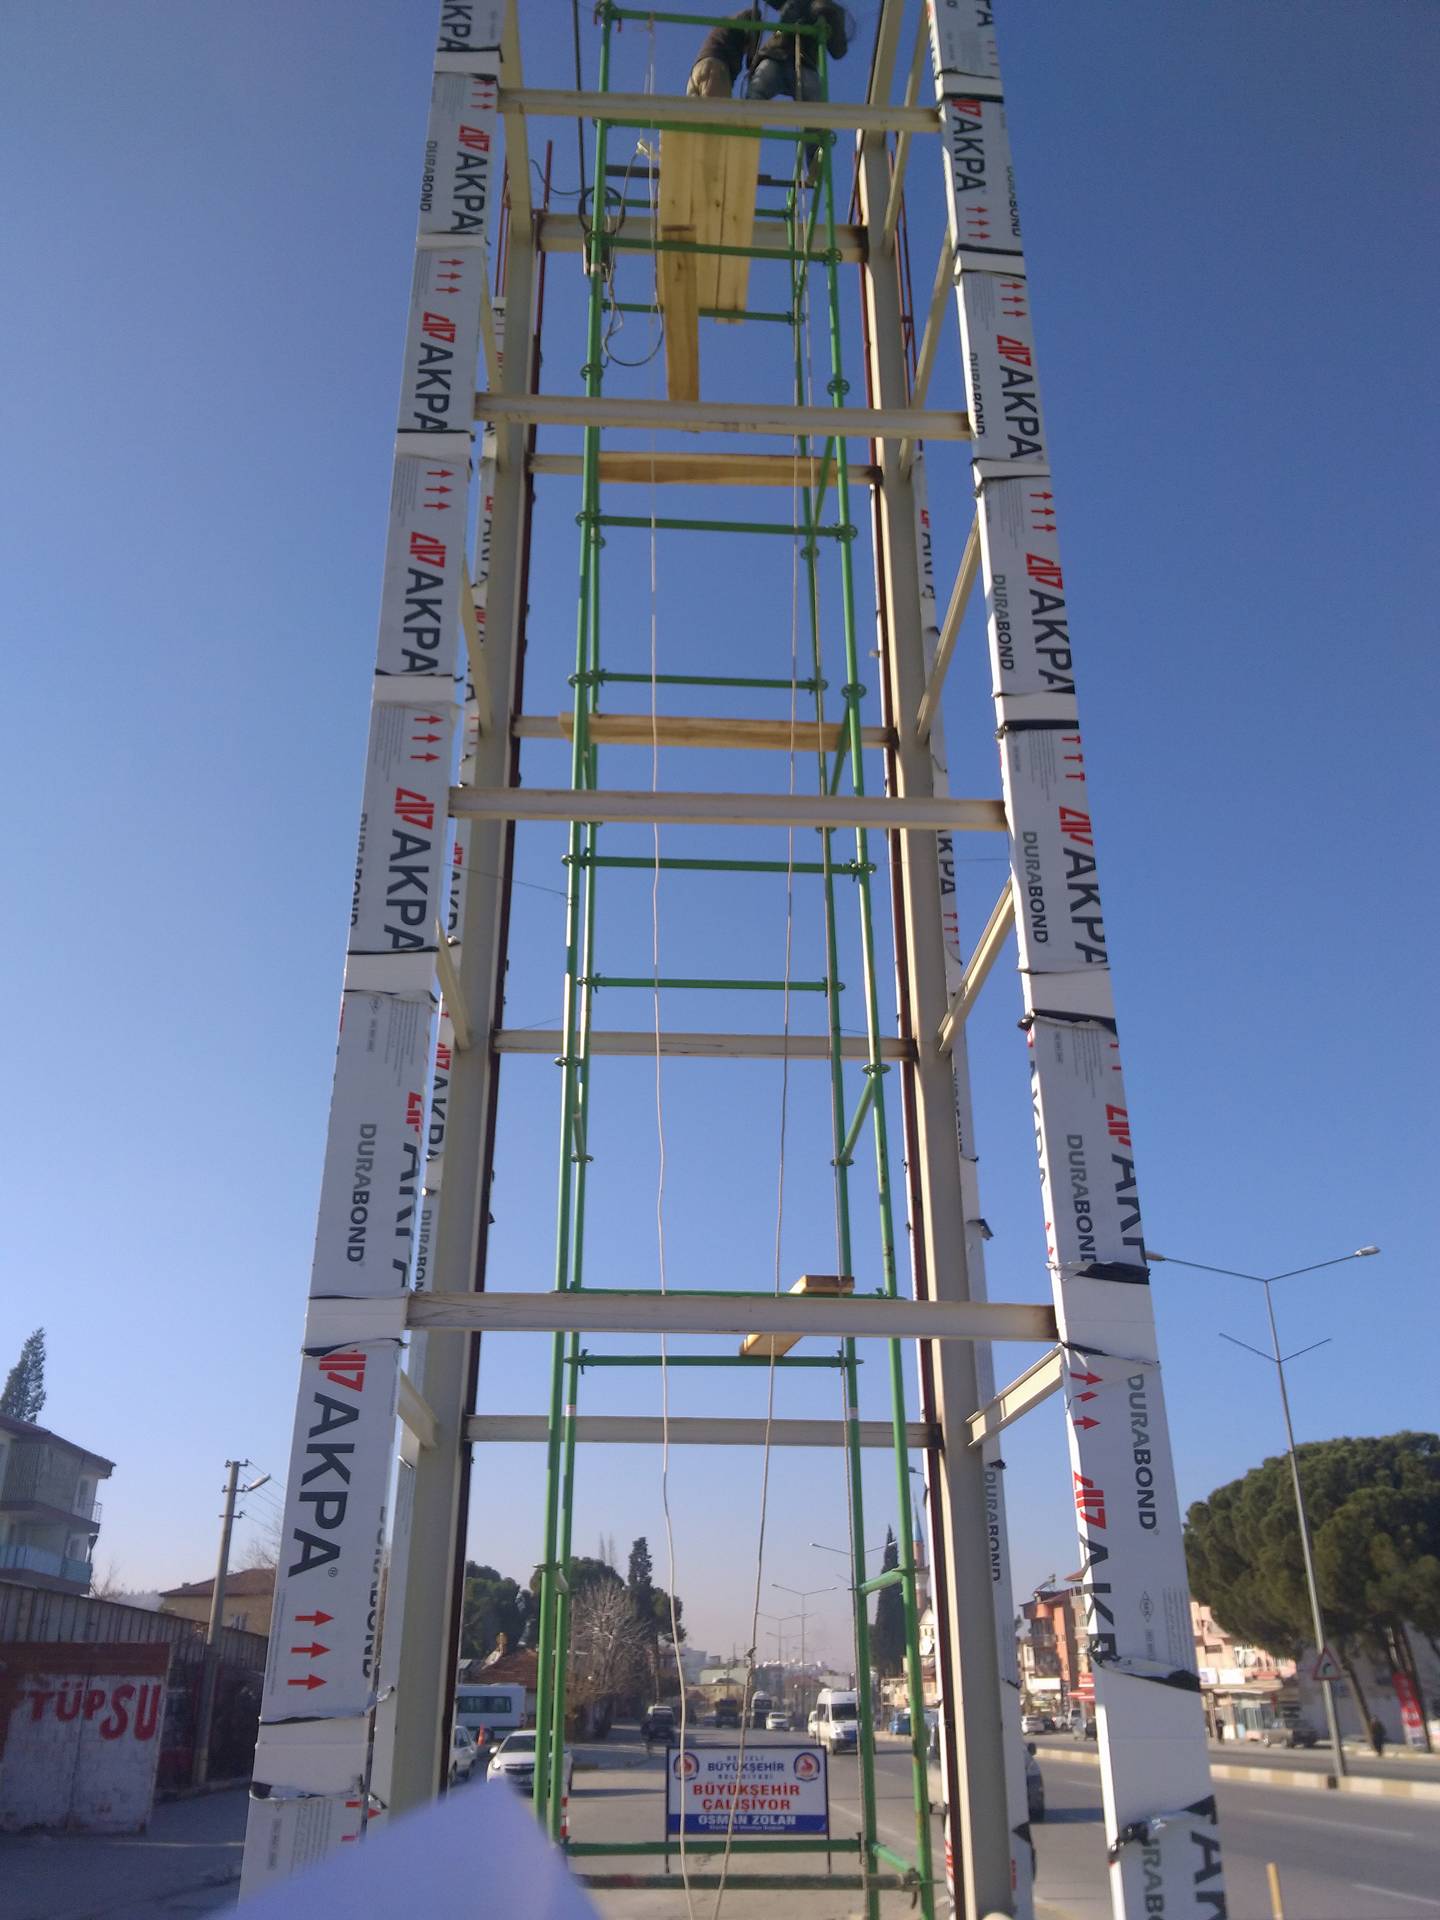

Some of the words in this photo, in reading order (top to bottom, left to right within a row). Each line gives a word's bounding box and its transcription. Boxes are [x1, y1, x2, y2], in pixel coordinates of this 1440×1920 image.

[420, 140, 438, 212] DURABOND
[450, 151, 488, 231] AKPA
[953, 116, 986, 192] AKPA
[413, 342, 454, 431] AKPA
[1000, 365, 1043, 459] AKPA
[400, 567, 445, 673] AKPA
[992, 573, 1014, 671] DURABOND
[383, 828, 432, 950] AKPA
[1022, 831, 1049, 944] DURABOND
[347, 1122, 378, 1264] DURABOND
[287, 1391, 360, 1578] AKPA
[1127, 1373, 1158, 1531] DURABOND
[693, 1783, 800, 1798] BÜYÜKŞEHİR
[702, 1799, 791, 1813] ÇALIŞIYOR
[751, 1815, 796, 1825] ZOLAN
